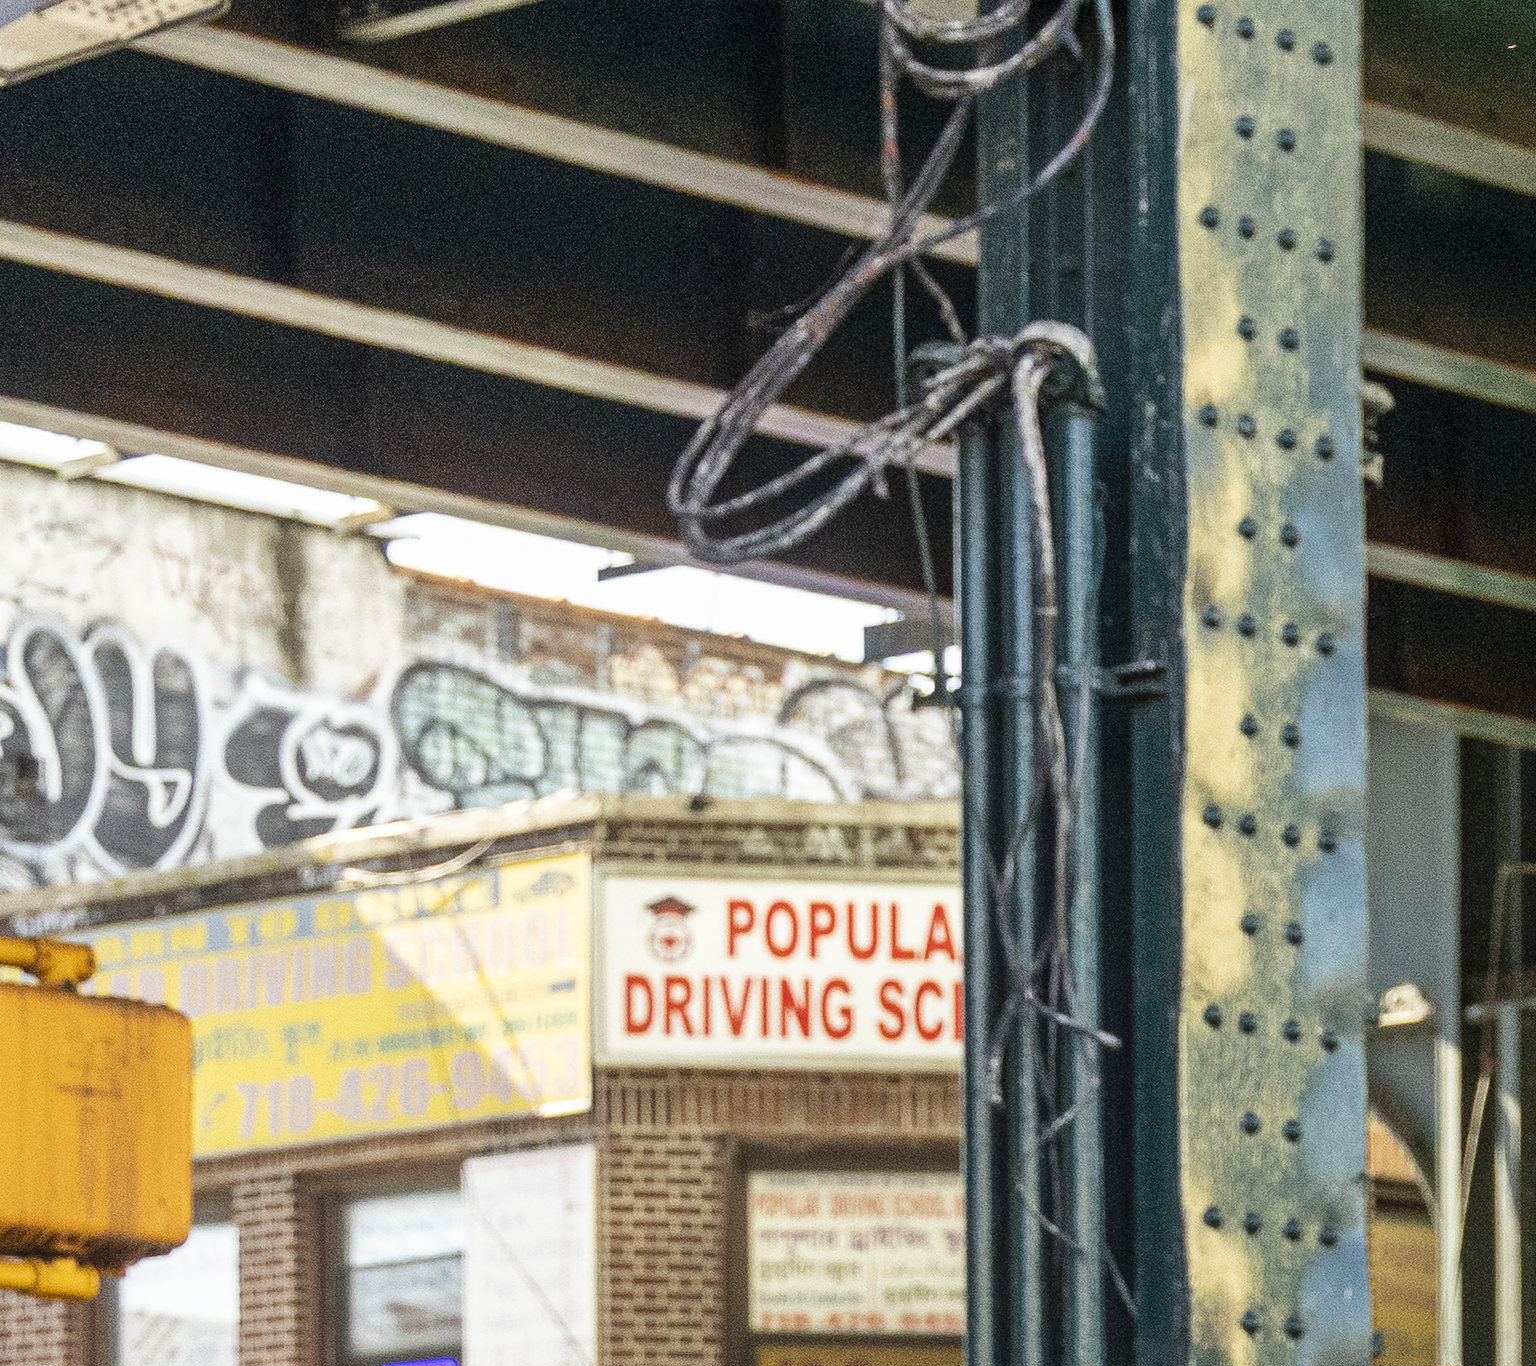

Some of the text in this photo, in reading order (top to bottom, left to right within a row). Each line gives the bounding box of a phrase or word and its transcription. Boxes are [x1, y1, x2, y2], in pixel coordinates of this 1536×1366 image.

[727, 898, 957, 960] POPULA
[180, 937, 373, 1019] DRIVING
[624, 973, 853, 1041] DRIVING
